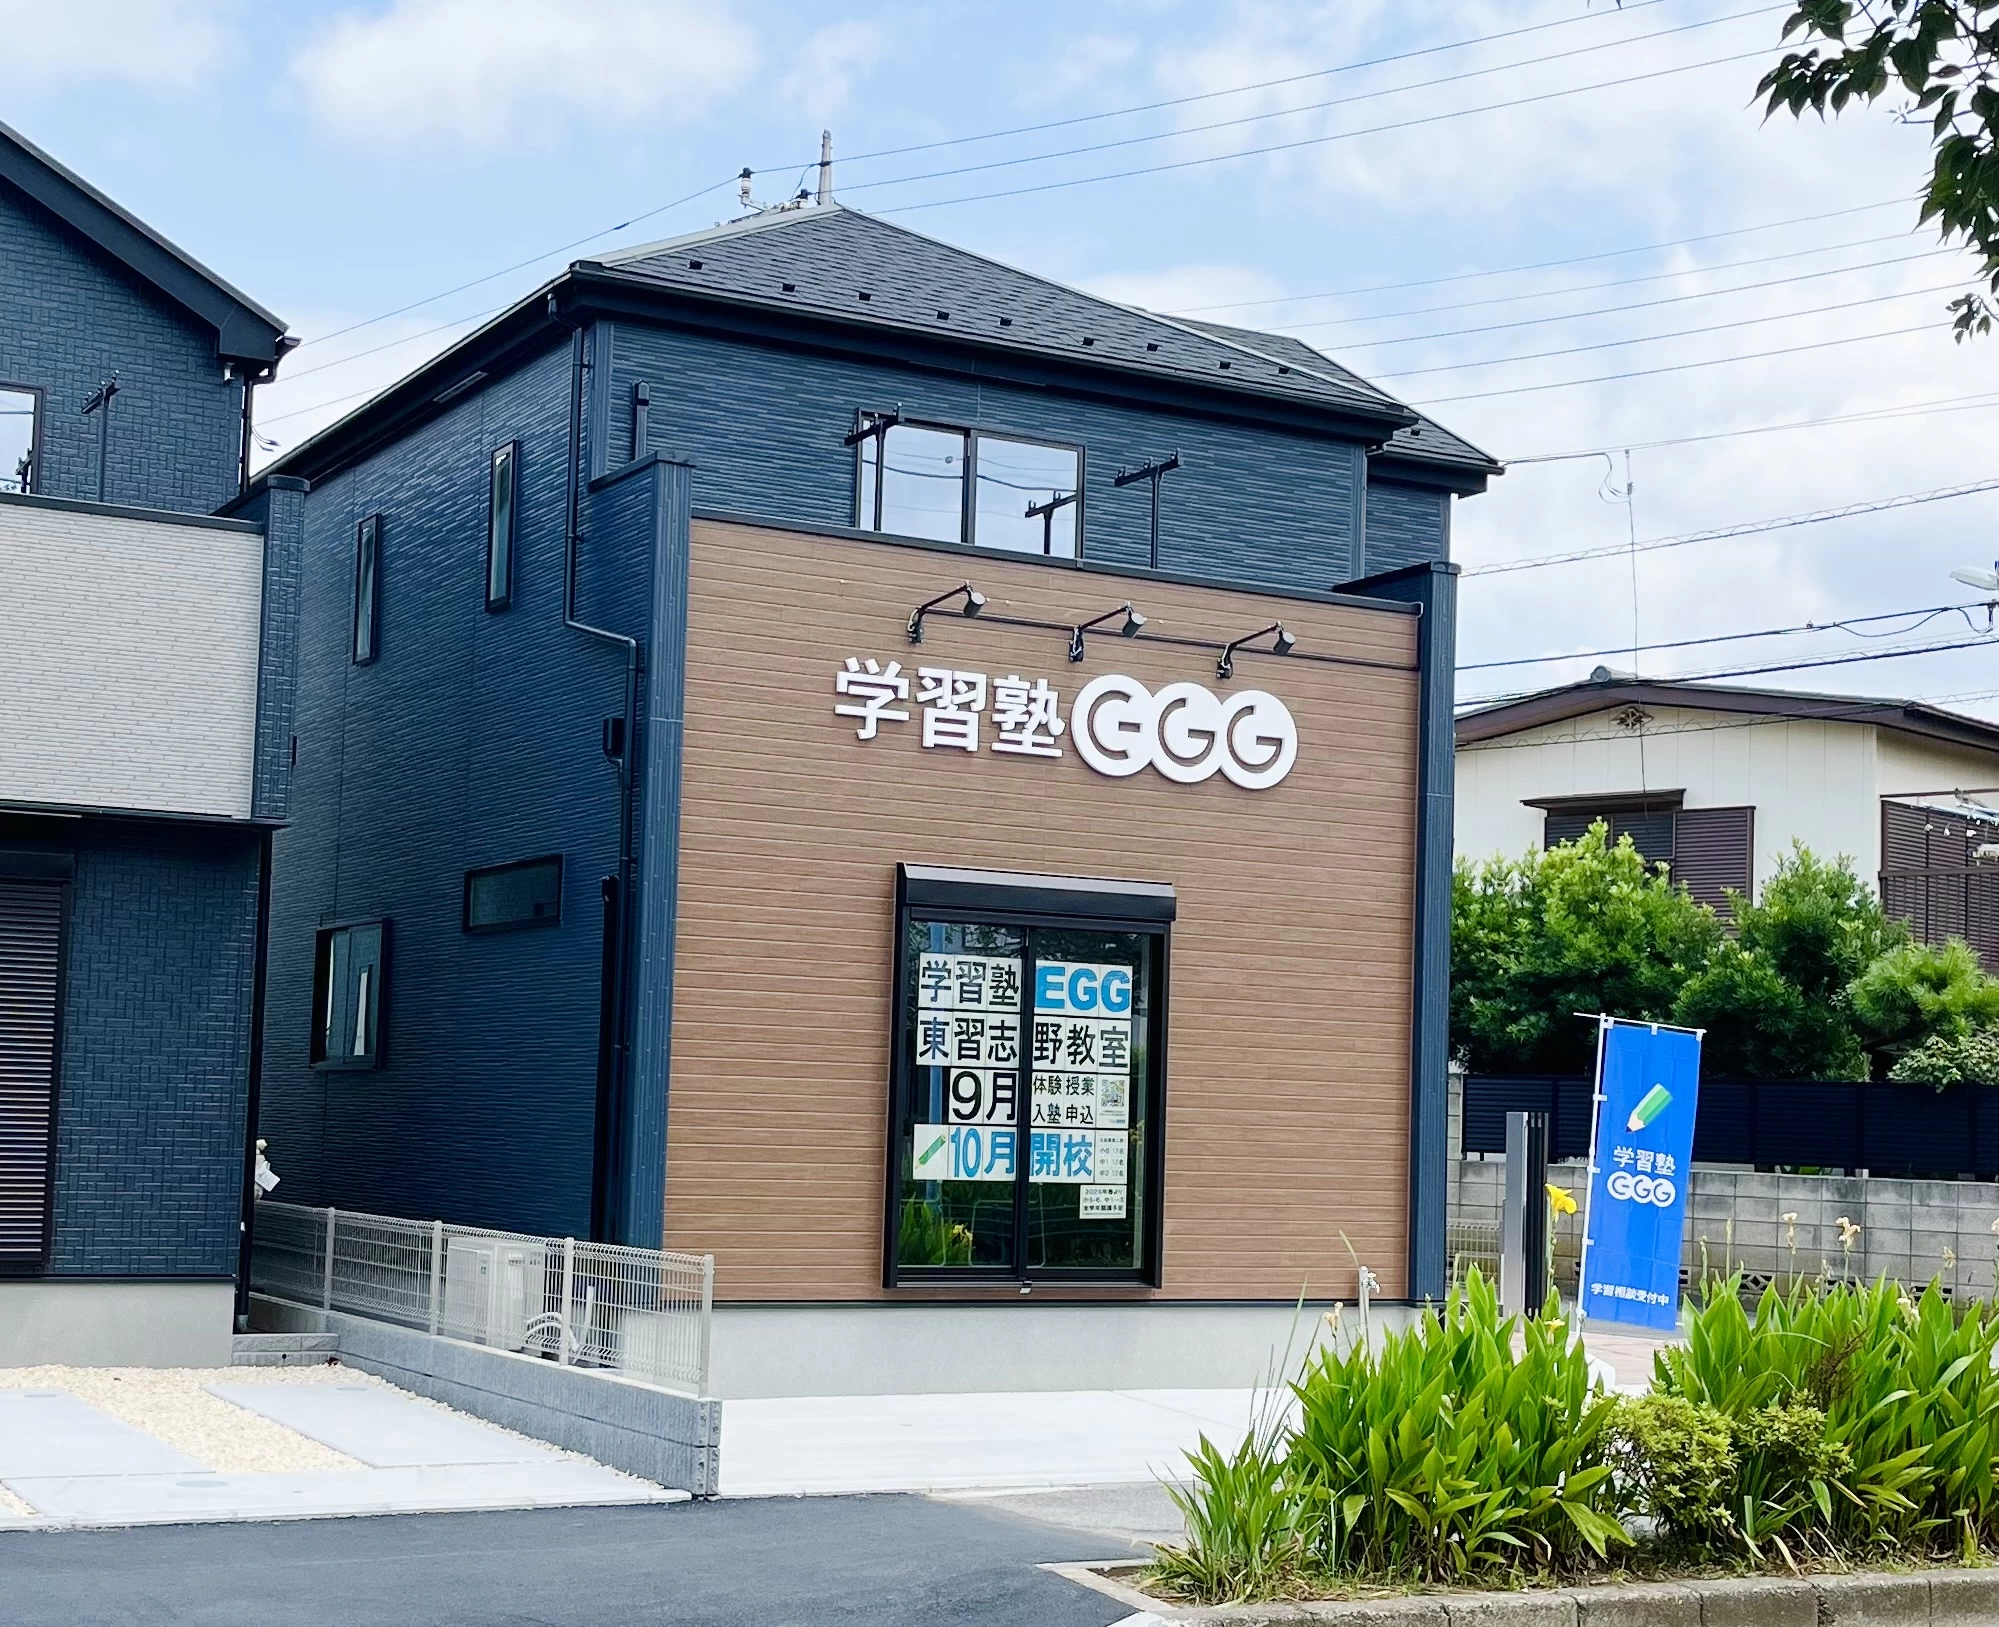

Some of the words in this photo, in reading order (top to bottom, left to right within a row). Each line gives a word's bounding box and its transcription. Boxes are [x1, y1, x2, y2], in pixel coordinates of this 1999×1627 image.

[835, 657, 1065, 758] 学習塾
[921, 960, 1019, 1006] 学習塾
[1036, 966, 1130, 1012] EGG
[952, 1070, 1016, 1122] 9月
[1033, 1074, 1095, 1096] 体験授業
[1033, 1102, 1094, 1124] 入塾申込
[1613, 1145, 1676, 1176] 学習塾
